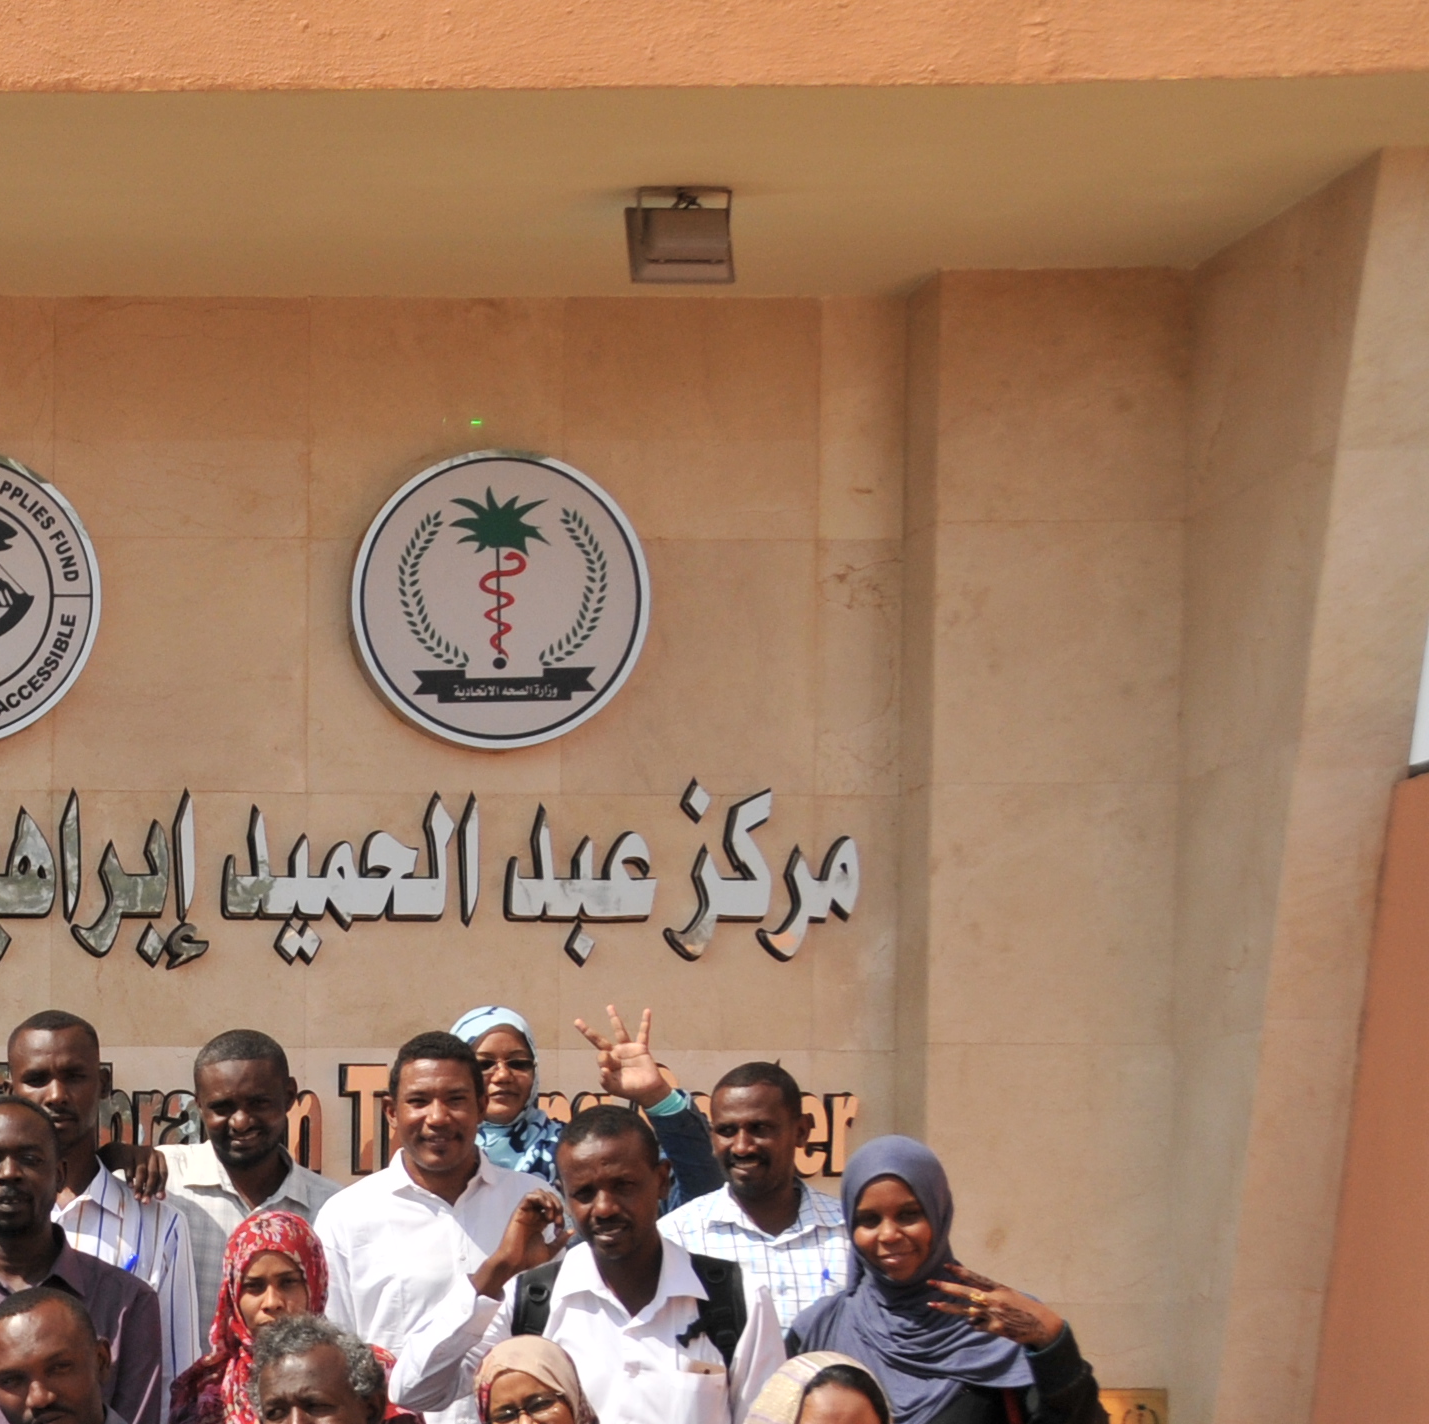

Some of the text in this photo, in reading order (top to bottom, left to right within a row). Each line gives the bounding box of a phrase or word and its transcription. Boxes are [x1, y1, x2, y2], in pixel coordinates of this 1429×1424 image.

[49, 526, 80, 582] FUND
[534, 683, 558, 698] وزارة
[220, 791, 481, 966] الحميد
[503, 802, 657, 967] عبد
[663, 777, 860, 962] مركز
